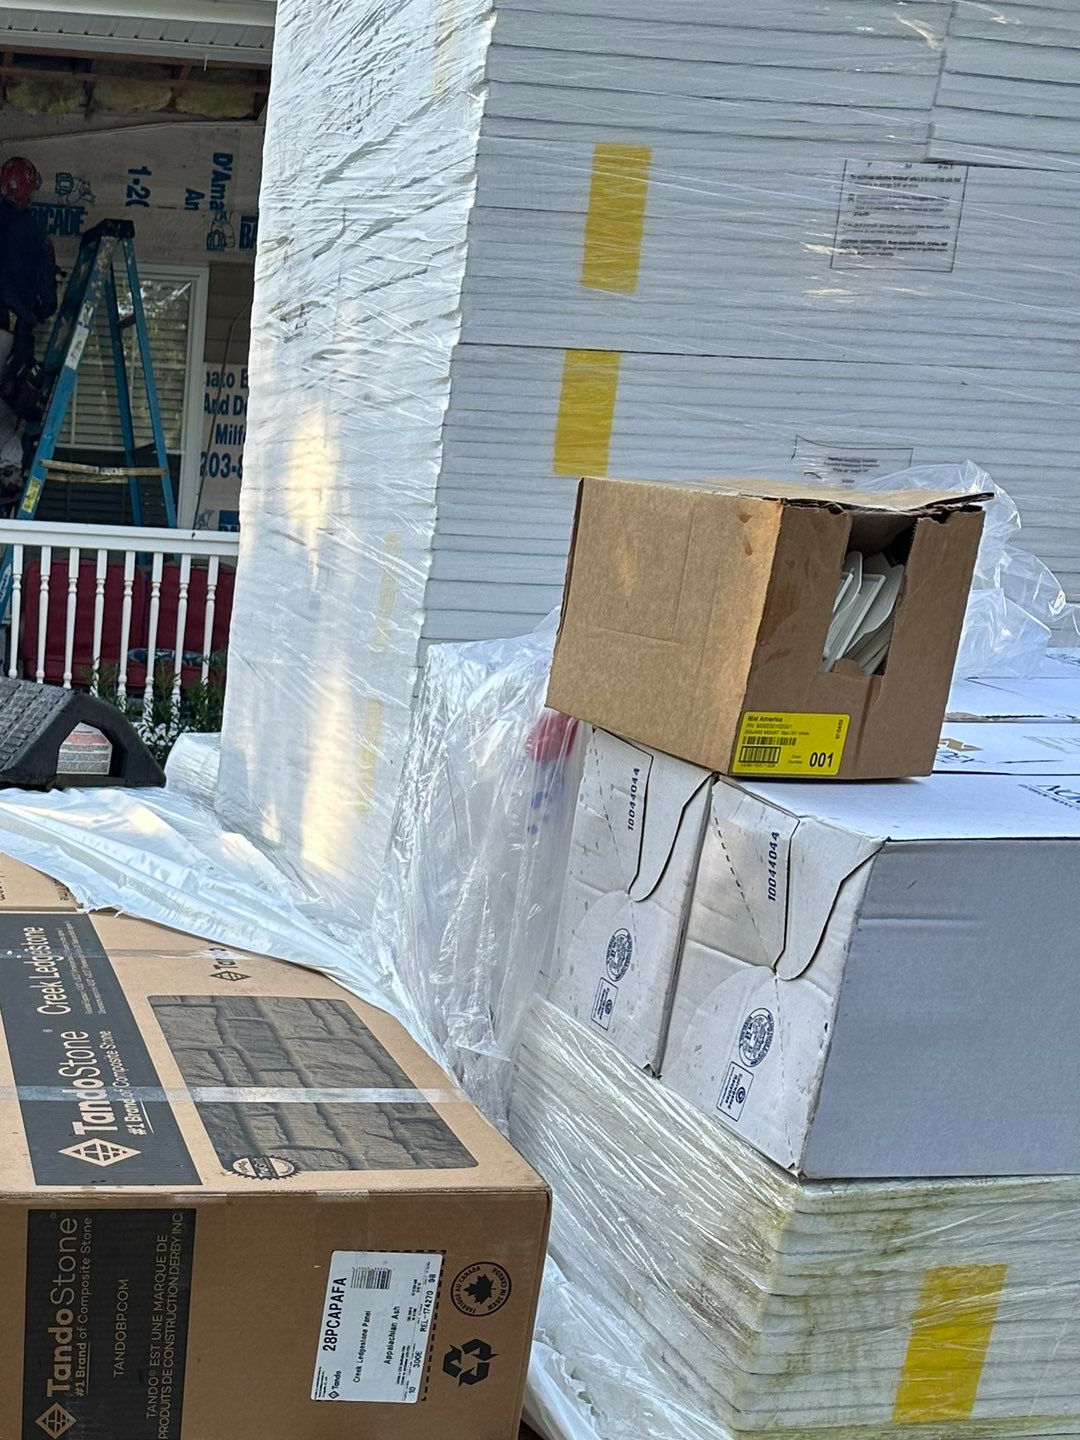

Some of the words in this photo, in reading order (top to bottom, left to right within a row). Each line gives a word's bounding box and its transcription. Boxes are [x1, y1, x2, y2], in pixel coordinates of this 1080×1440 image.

[809, 752, 834, 767] 001
[627, 767, 640, 831] 10044044
[767, 831, 780, 902] 10044044
[23, 926, 63, 979] Ledgestone
[37, 979, 71, 1015] Creek
[99, 1030, 119, 1050] Stone
[59, 1030, 119, 1135] TandoStone
[111, 1048, 132, 1088] Composite
[123, 1095, 145, 1119] Brand
[81, 1217, 93, 1254] Stone
[156, 1235, 168, 1252] DE
[169, 1237, 182, 1276] DERBY
[78, 1257, 91, 1324] Composite
[153, 1262, 167, 1311] MARQUE
[47, 1217, 78, 1397] TandoStone
[163, 1277, 180, 1368] CONSTRUCTION
[323, 1278, 347, 1352] 28PCAPAFA
[362, 1310, 371, 1329] Panel
[420, 1290, 434, 1333] REL-174270
[77, 1326, 87, 1339] of
[151, 1315, 163, 1341] UNE
[384, 1322, 398, 1364] Appalachian
[75, 1343, 87, 1380] Brand
[150, 1344, 160, 1367] EST
[356, 1330, 369, 1366] Ledgestone
[75, 1381, 85, 1397] #1
[162, 1369, 173, 1386] DE
[332, 1370, 341, 1390] Tando
[353, 1366, 362, 1383] Creek
[159, 1386, 172, 1440] PRODUITS
